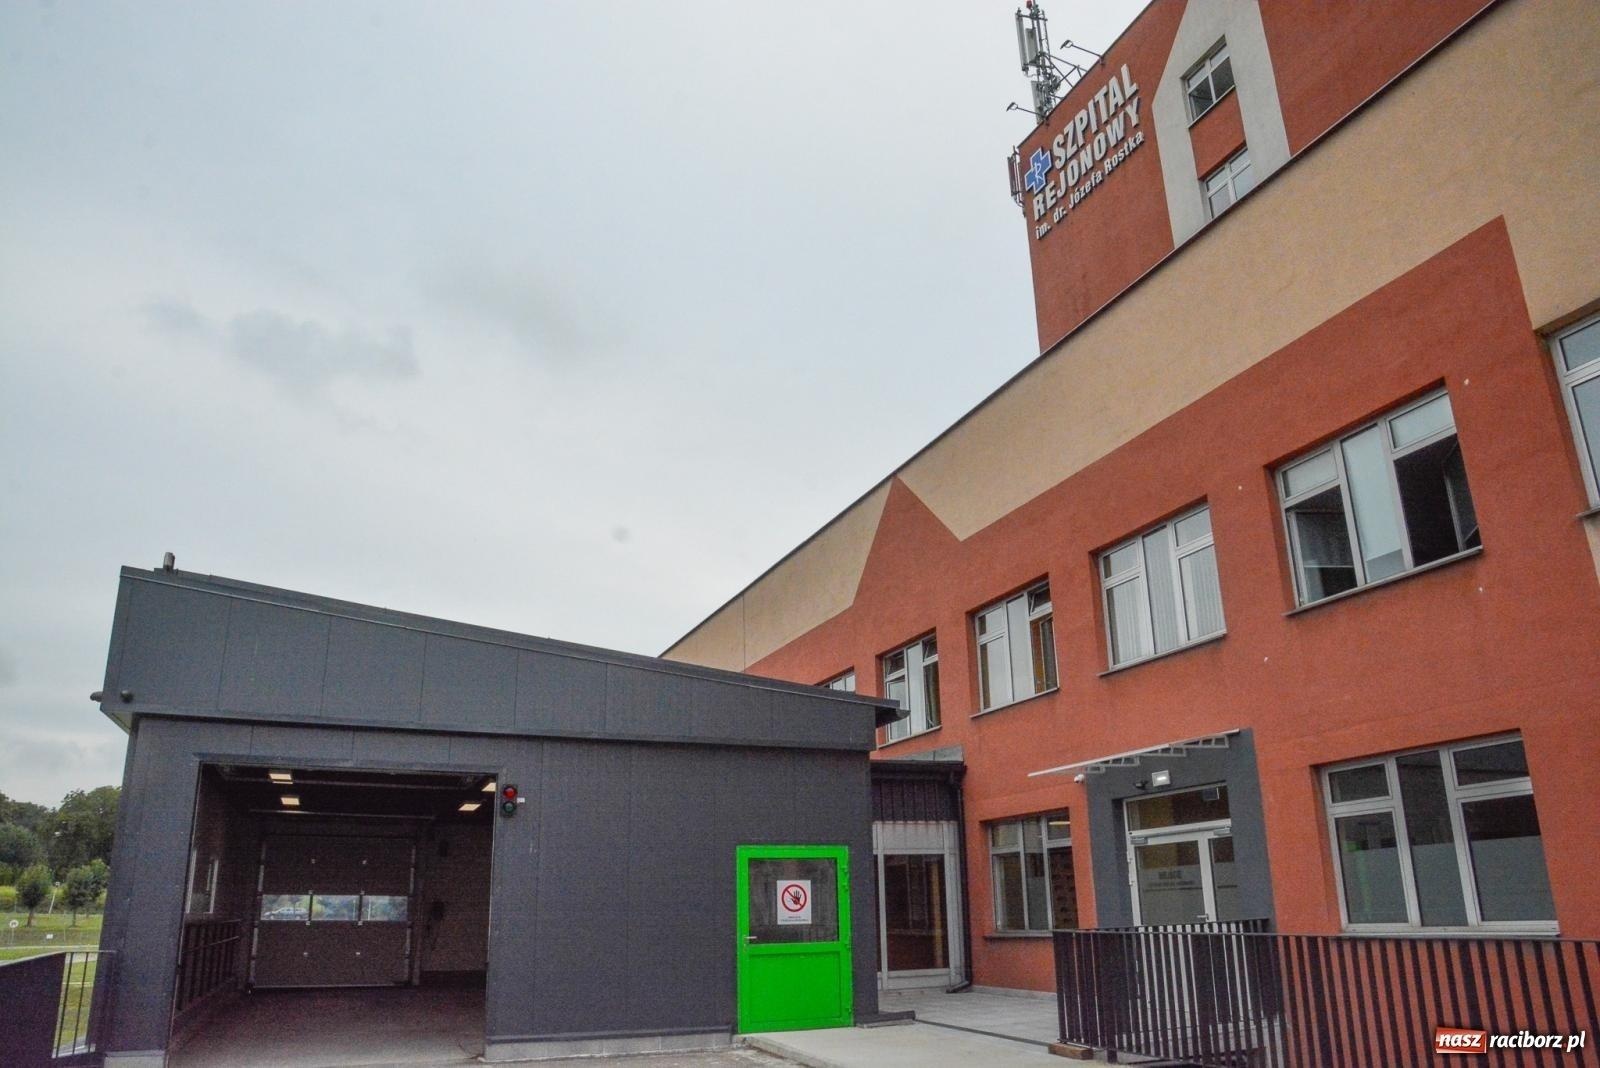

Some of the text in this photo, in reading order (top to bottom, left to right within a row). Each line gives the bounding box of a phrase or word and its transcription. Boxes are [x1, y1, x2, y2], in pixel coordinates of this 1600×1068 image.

[1032, 97, 1140, 220] REJONOWY
[1053, 64, 1138, 169] SZPITAL
[1035, 131, 1145, 240] im. dr. Józefa Rostka
